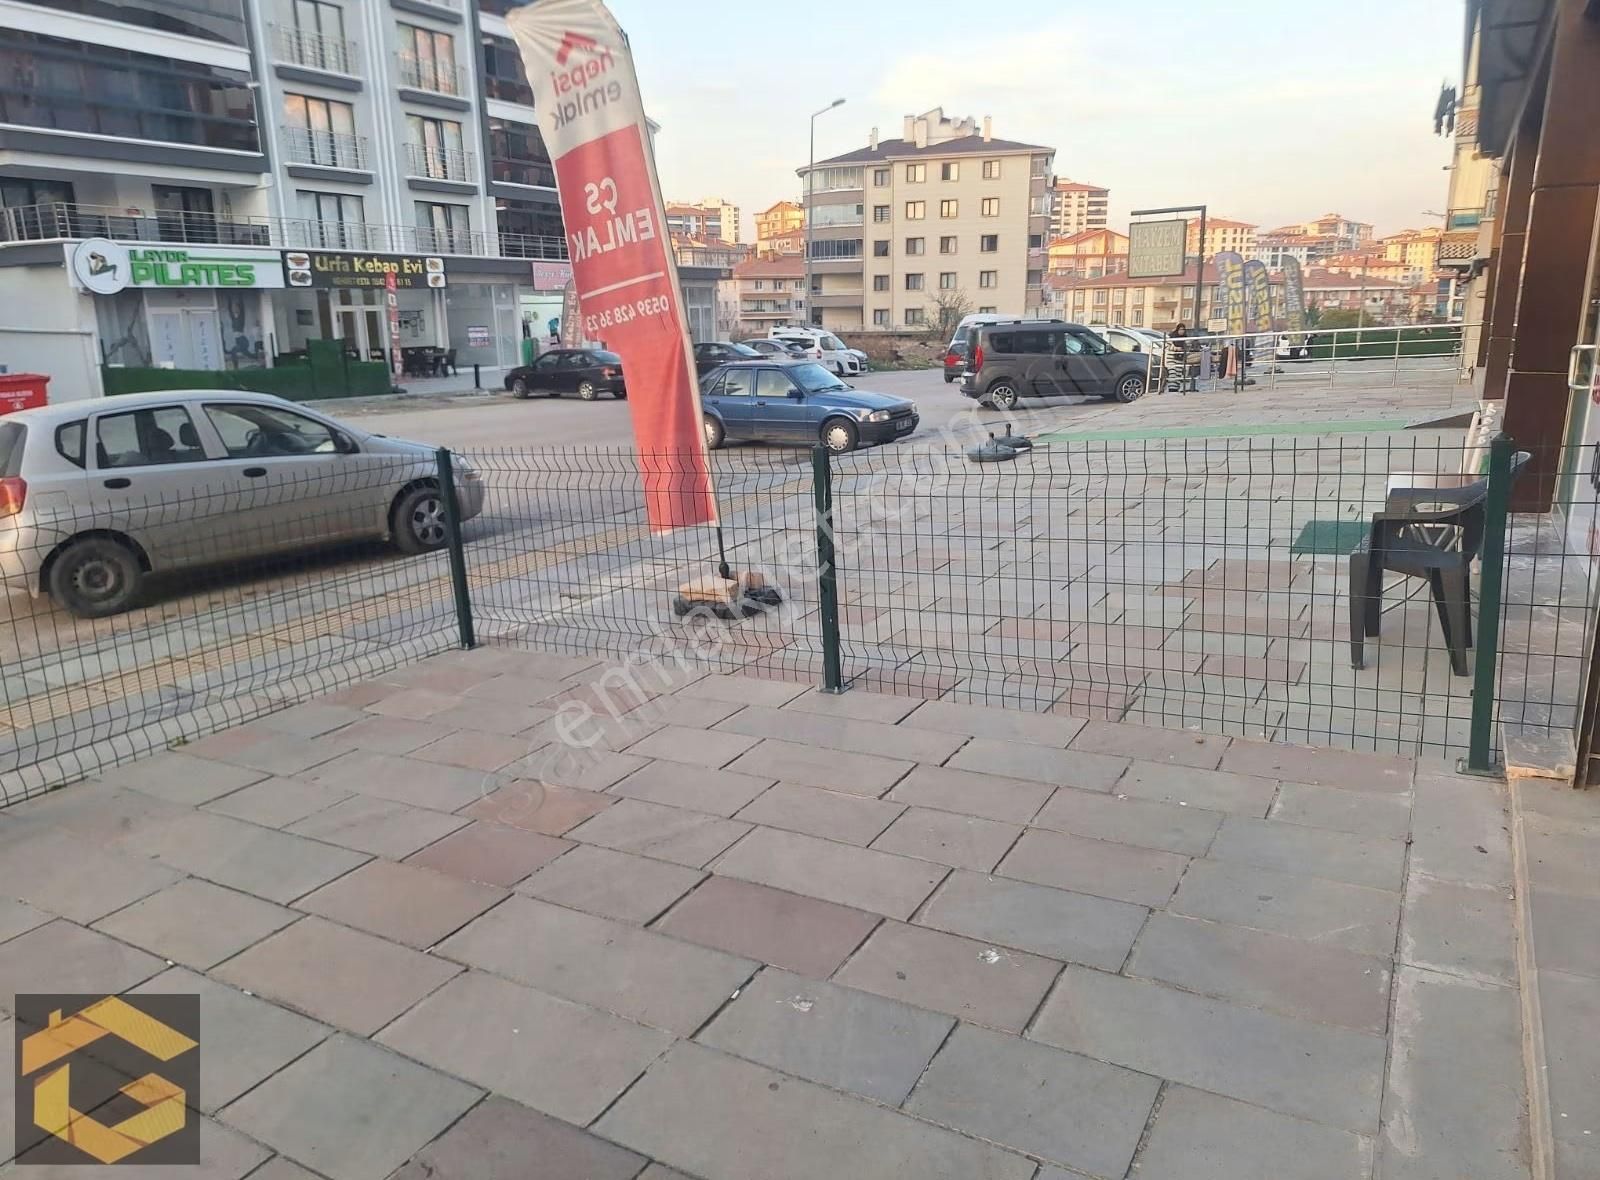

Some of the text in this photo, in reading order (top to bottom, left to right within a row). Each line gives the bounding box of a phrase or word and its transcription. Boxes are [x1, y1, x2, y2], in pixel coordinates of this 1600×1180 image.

[131, 263, 255, 286] PILATES
[314, 255, 349, 272] Urfa
[402, 258, 423, 274] Evi
